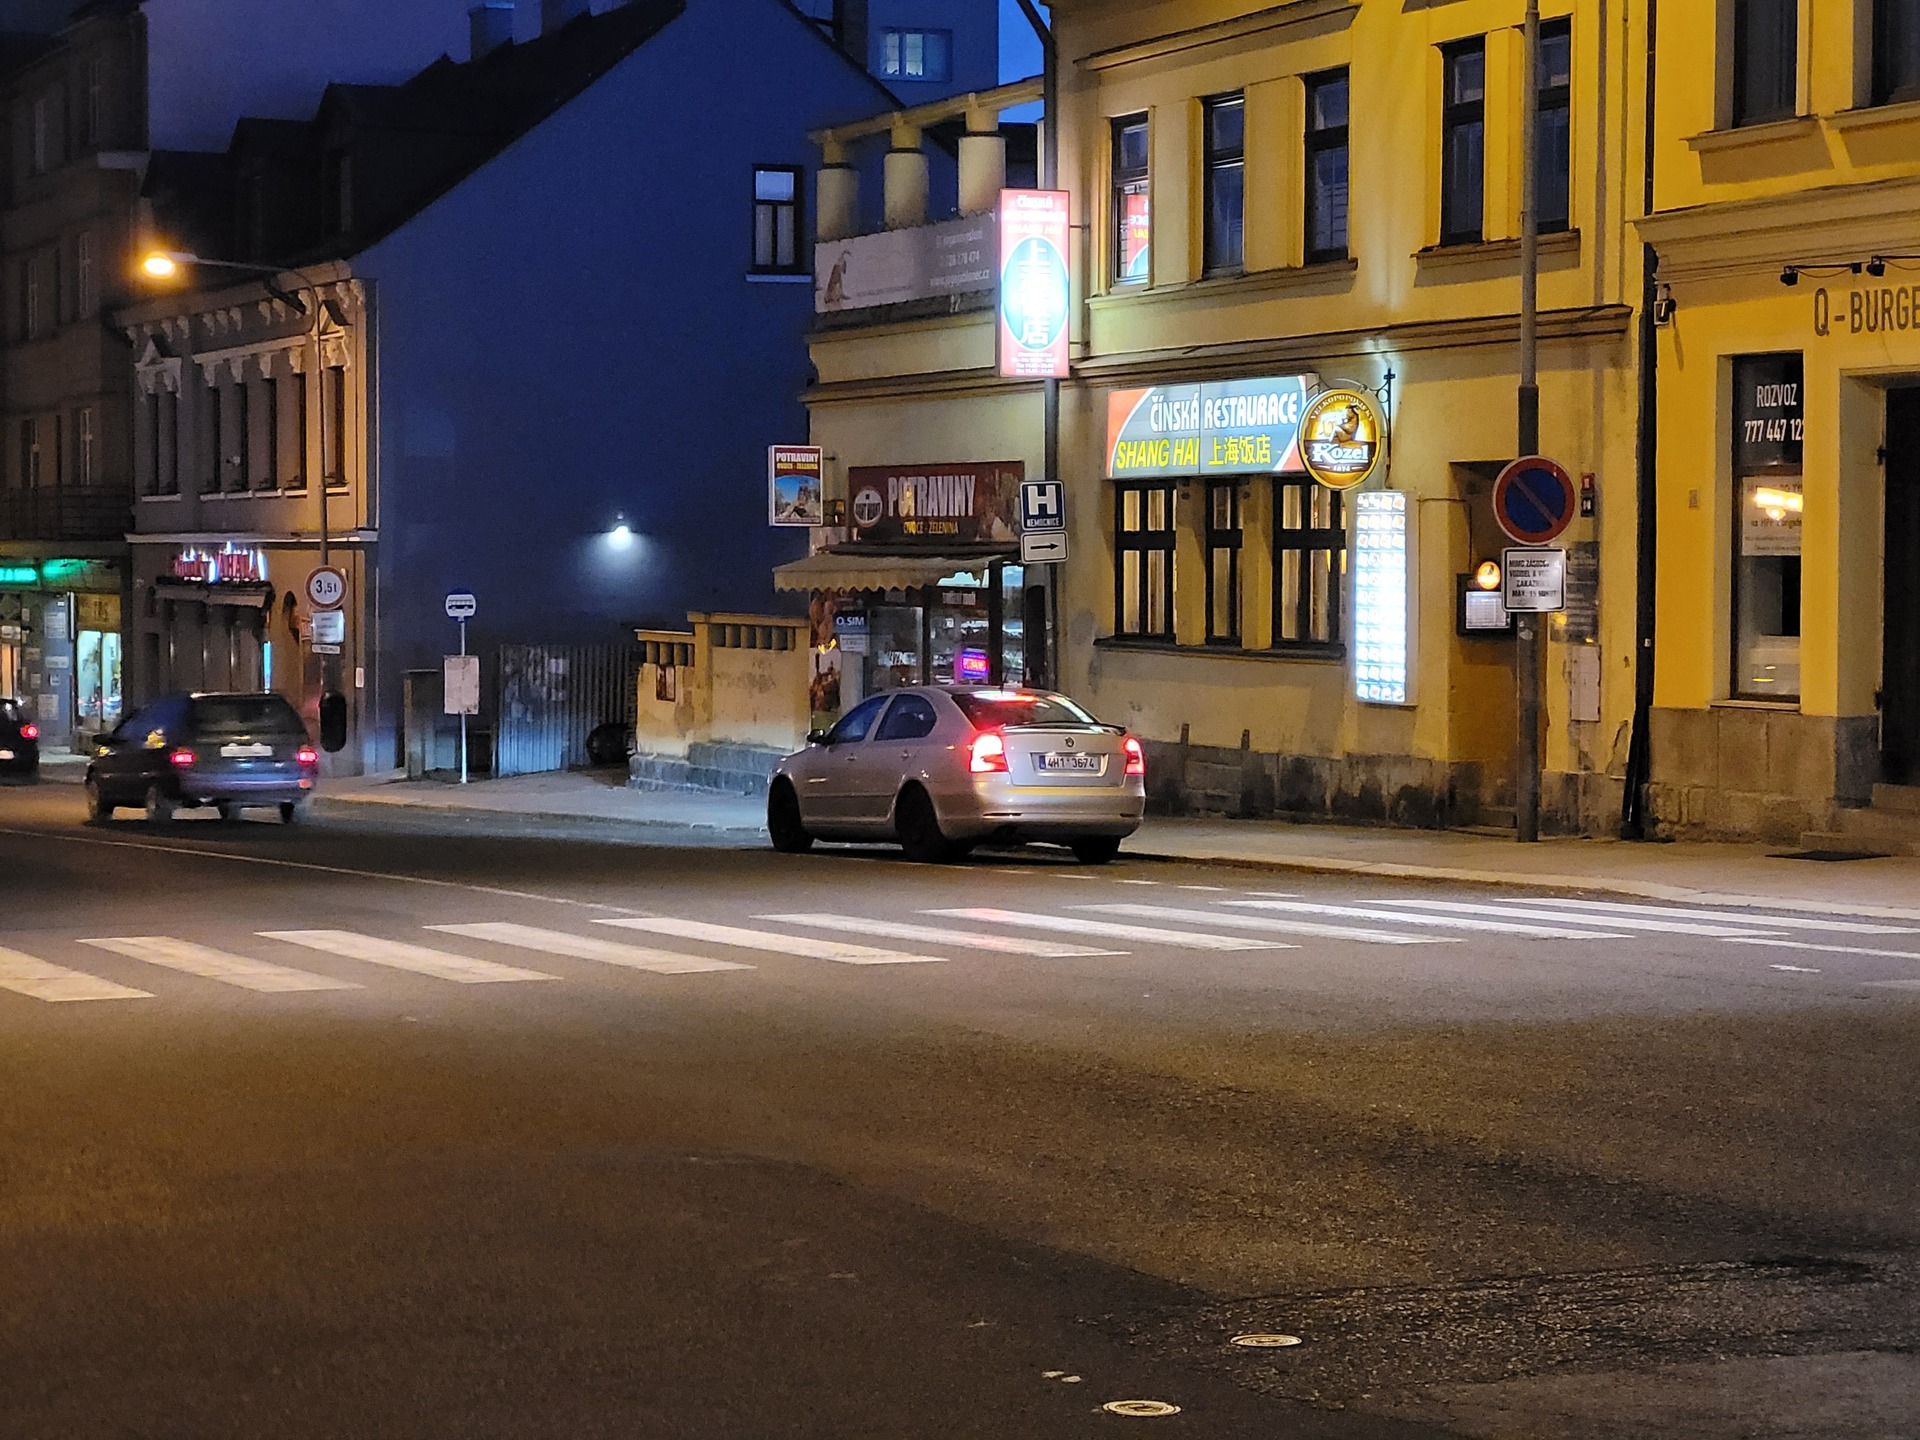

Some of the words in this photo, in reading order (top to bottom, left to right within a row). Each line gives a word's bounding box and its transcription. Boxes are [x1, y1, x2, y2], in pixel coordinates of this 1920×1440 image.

[1756, 383, 1797, 407] ROZVOZ
[1151, 393, 1199, 432] ČÍNSKÁ
[1204, 393, 1298, 429] RESTAURACE
[1744, 419, 1764, 443] 777
[1766, 418, 1787, 442] 447
[776, 453, 818, 463] POTRAVINY
[1116, 438, 1169, 469] SHANG
[1173, 437, 1199, 466] HAI
[1208, 433, 1271, 466] 上海饭店
[1312, 443, 1368, 464] Kozel
[888, 475, 976, 517] POTRAVINY
[1027, 485, 1057, 516] H
[928, 521, 960, 534] ZELENINA
[1026, 517, 1060, 528] NEMOCNICE
[1047, 757, 1065, 768] 4H1
[1072, 757, 1095, 769] 3674
